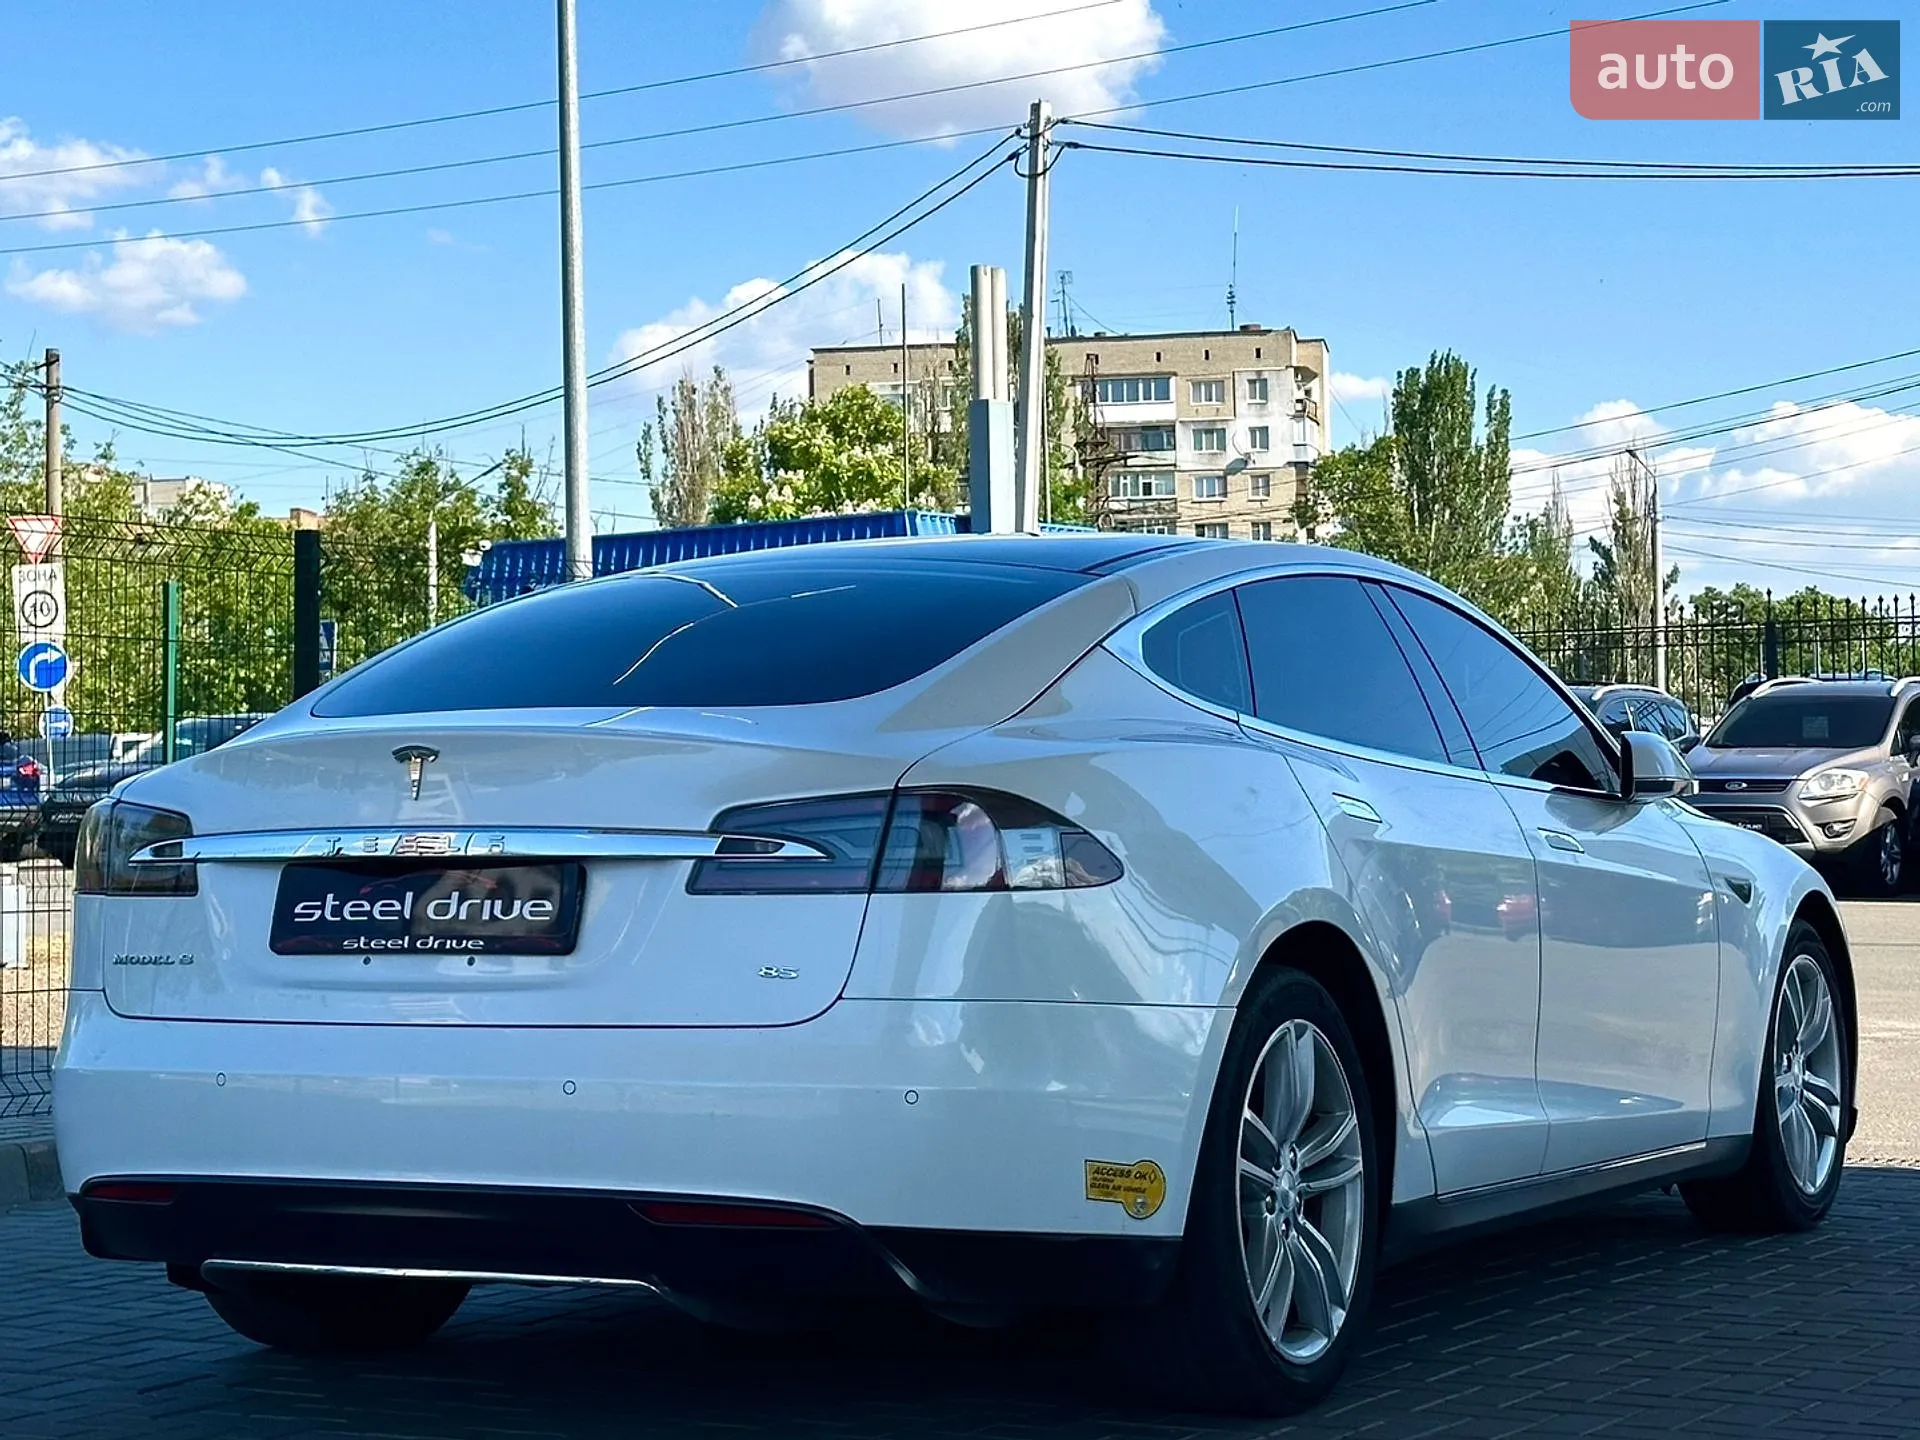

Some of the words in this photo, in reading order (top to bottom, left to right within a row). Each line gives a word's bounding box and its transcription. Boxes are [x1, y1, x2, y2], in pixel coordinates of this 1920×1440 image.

[19, 568, 58, 583] ЗОНА
[294, 891, 413, 921] steel
[426, 891, 554, 921] drive
[342, 935, 408, 949] steel
[416, 935, 485, 949] drive
[112, 954, 176, 966] MODEL
[757, 964, 800, 980] 85
[1092, 1166, 1132, 1179] ACCESS
[1133, 1170, 1148, 1181] OK
